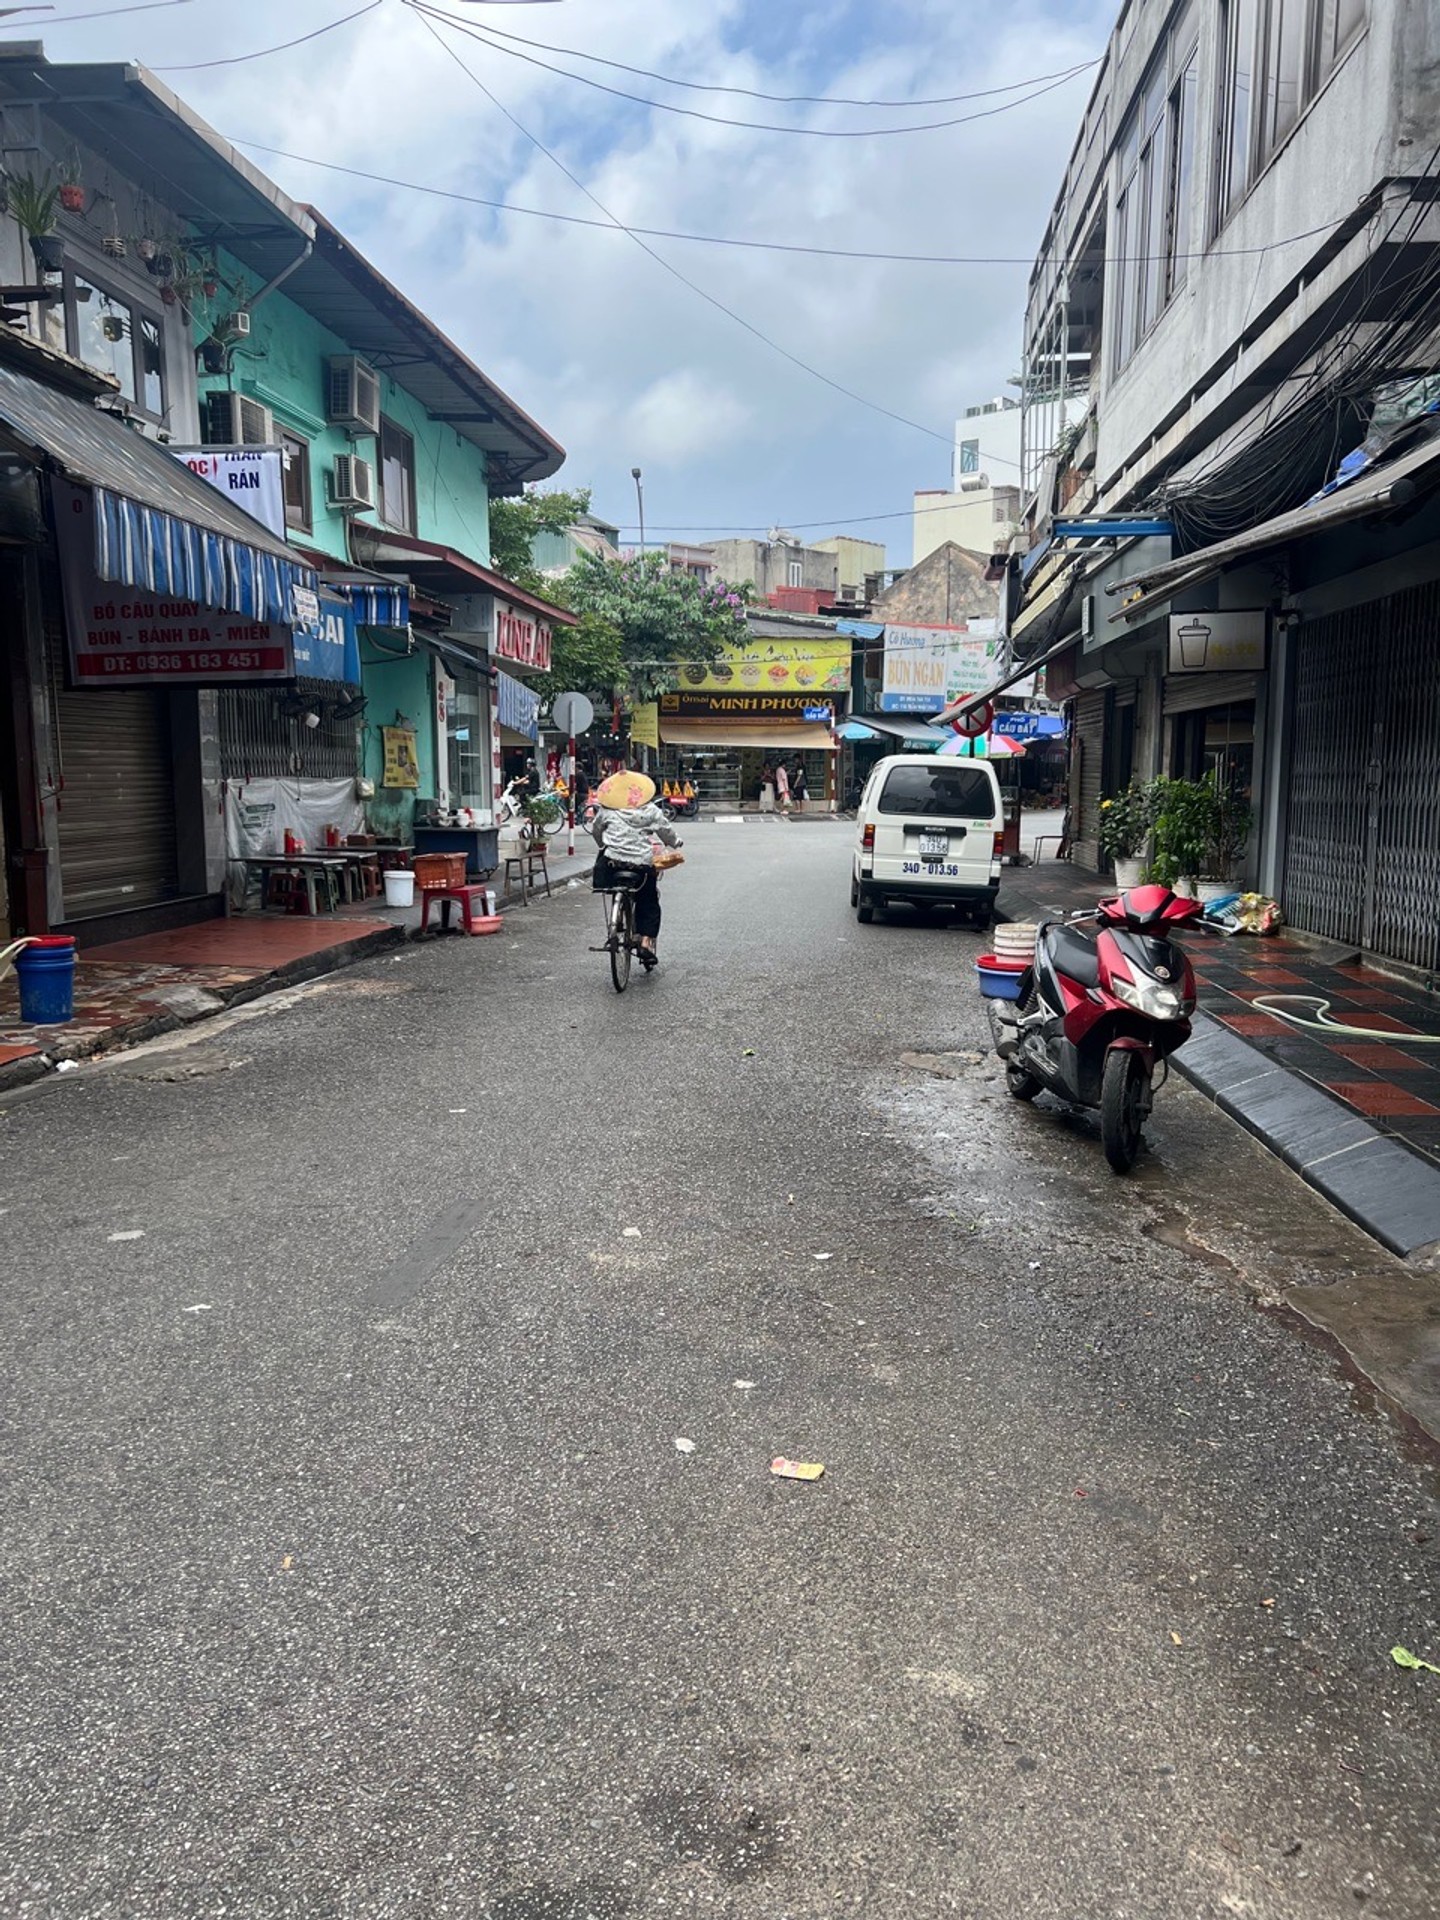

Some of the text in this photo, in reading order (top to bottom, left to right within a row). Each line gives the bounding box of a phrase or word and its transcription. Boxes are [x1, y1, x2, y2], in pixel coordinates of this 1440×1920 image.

[228, 468, 260, 490] RÁN
[159, 602, 199, 619] QUAY
[87, 627, 122, 646] BÚN
[138, 625, 183, 643] BÁNH
[136, 655, 181, 670] 0936
[188, 654, 222, 669] 183
[227, 652, 260, 667] 451
[709, 698, 757, 710] MINH
[928, 864, 958, 876] 013.56
